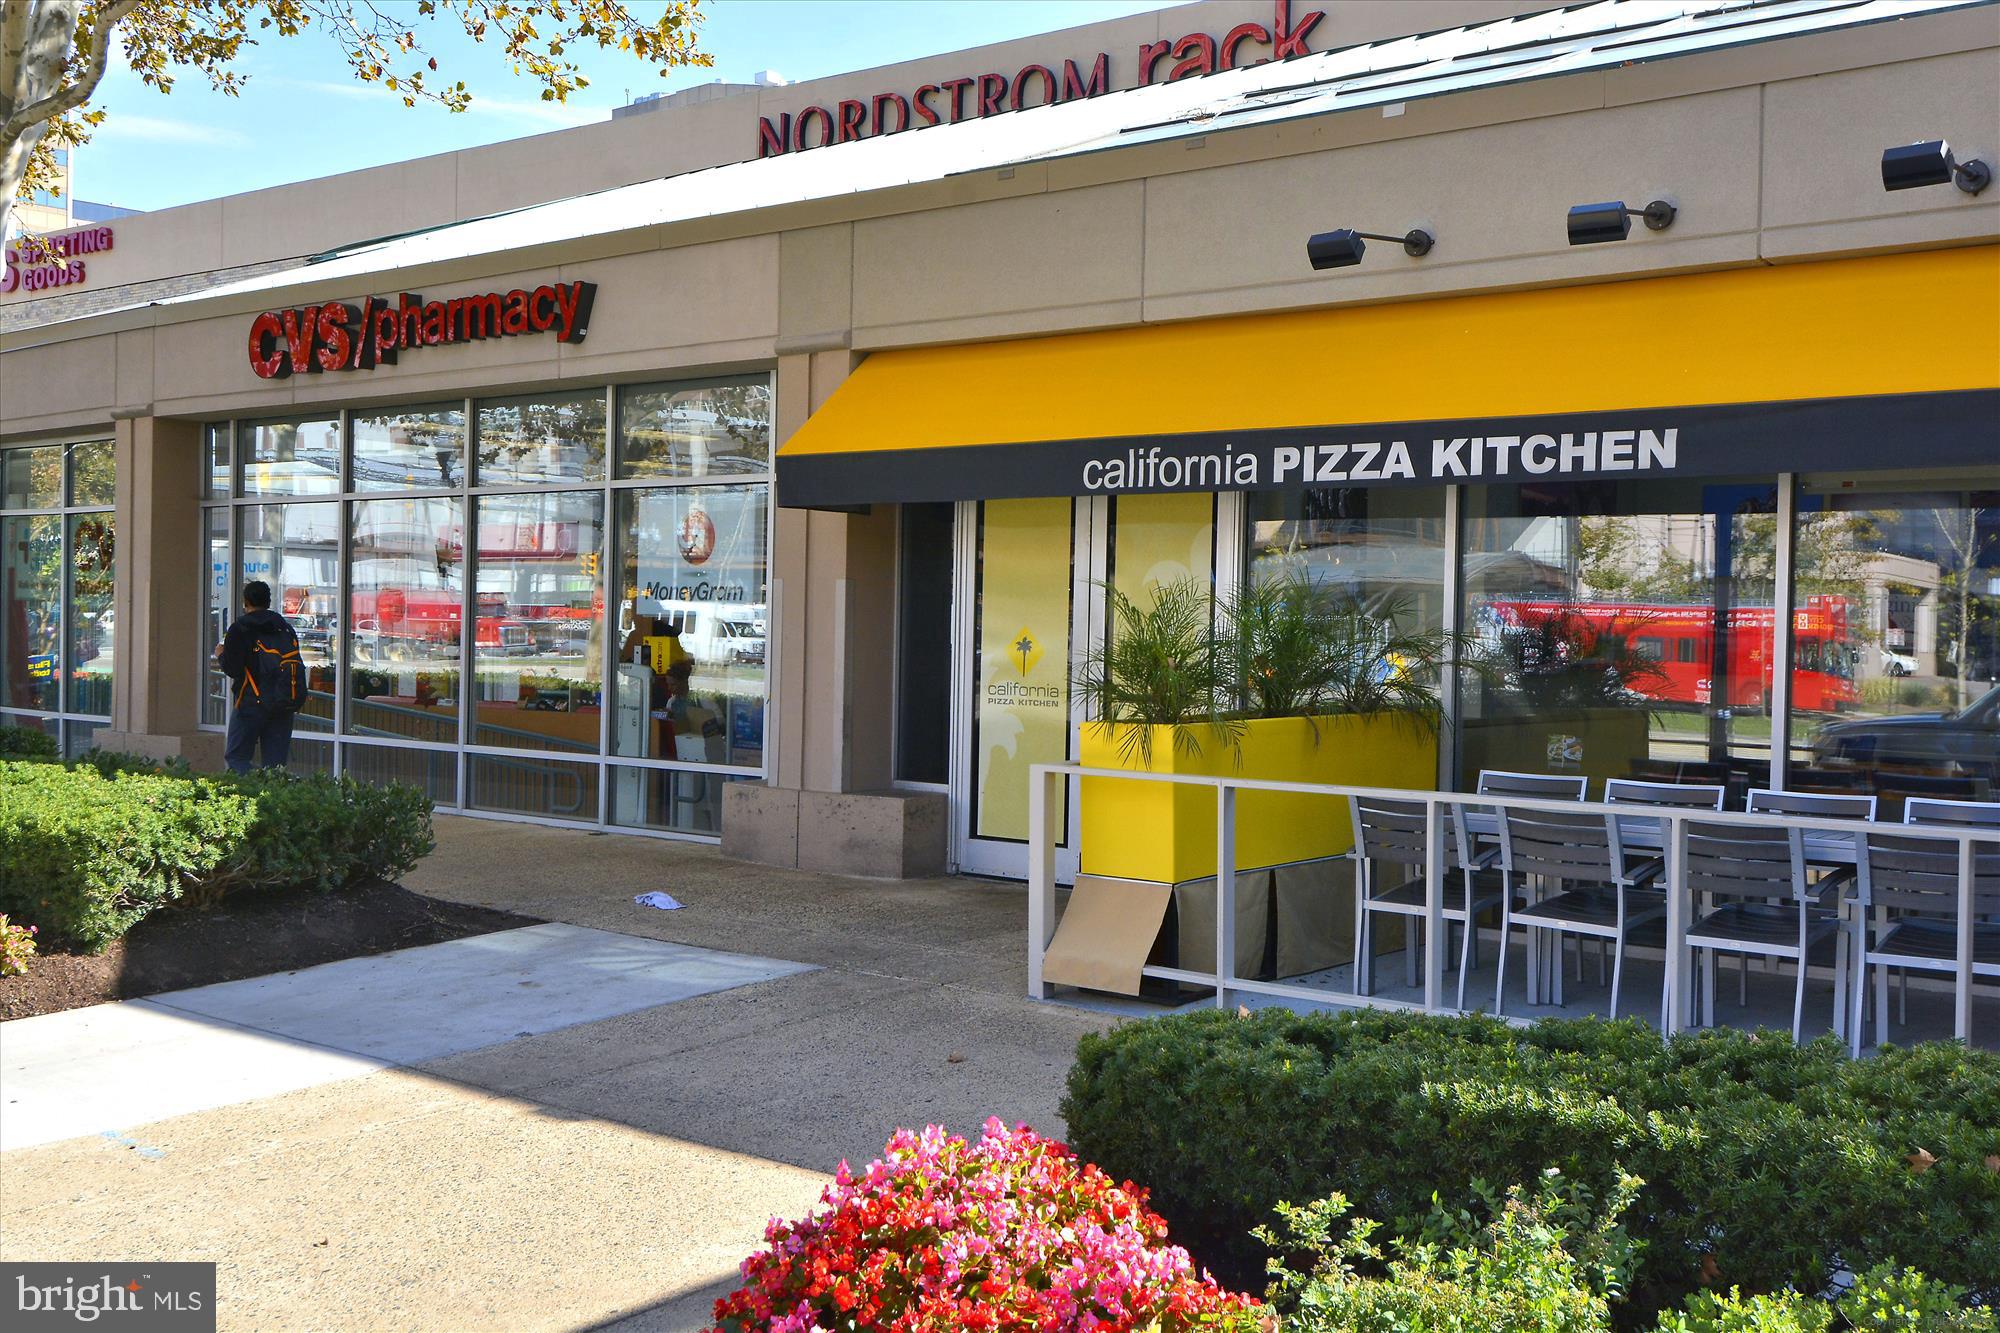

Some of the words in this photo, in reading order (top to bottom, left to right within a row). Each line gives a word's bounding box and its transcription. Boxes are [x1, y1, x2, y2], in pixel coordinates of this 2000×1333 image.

[759, 52, 1109, 159] NORDSTROM
[1138, 0, 1326, 87] rack
[22, 260, 86, 291] GOODS
[249, 281, 598, 379] CVS/pharmacy
[1083, 444, 1258, 490] california
[1273, 441, 1416, 483] PIZZA
[1431, 428, 1678, 477] KITCHEN
[645, 582, 744, 601] MoneyGram
[987, 682, 1059, 698] california
[987, 697, 1015, 706] PIZZA
[1018, 699, 1059, 708] KITCHEN
